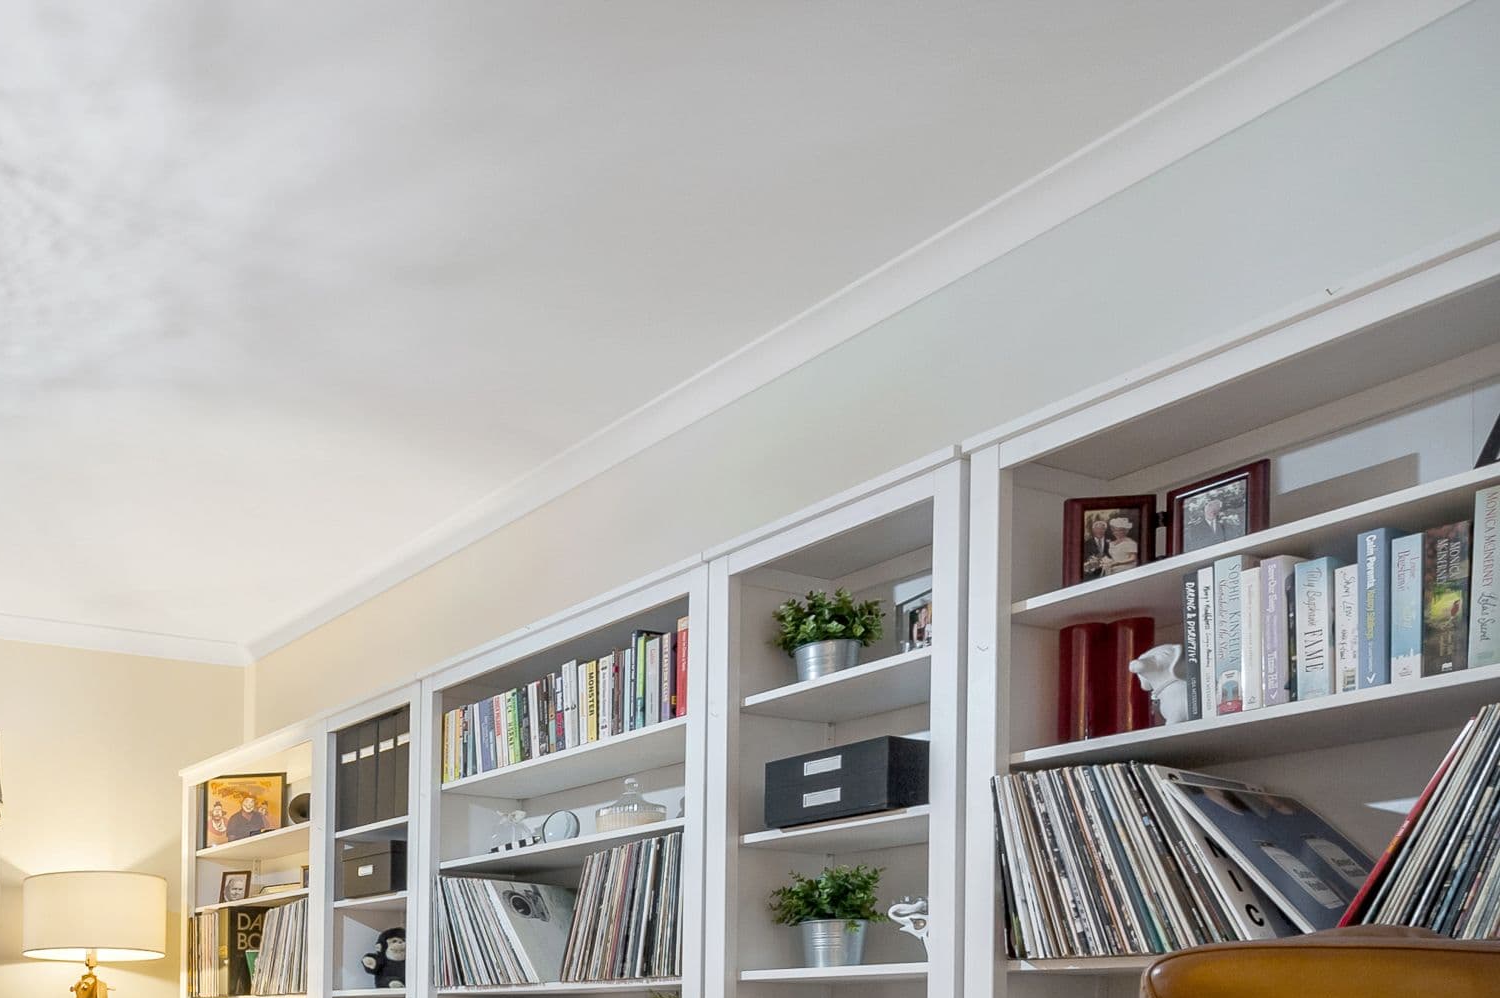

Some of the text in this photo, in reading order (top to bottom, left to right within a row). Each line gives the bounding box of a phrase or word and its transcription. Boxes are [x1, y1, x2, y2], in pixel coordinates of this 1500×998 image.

[1485, 491, 1500, 532] MONICA
[1448, 541, 1462, 579] MONICA
[1184, 581, 1197, 612] DARING
[1227, 563, 1242, 664] SOPHIE KINSELLA
[1186, 620, 1198, 664] DISRUPTIVE
[1303, 628, 1324, 673] FAME
[587, 671, 596, 717] MONSTER
